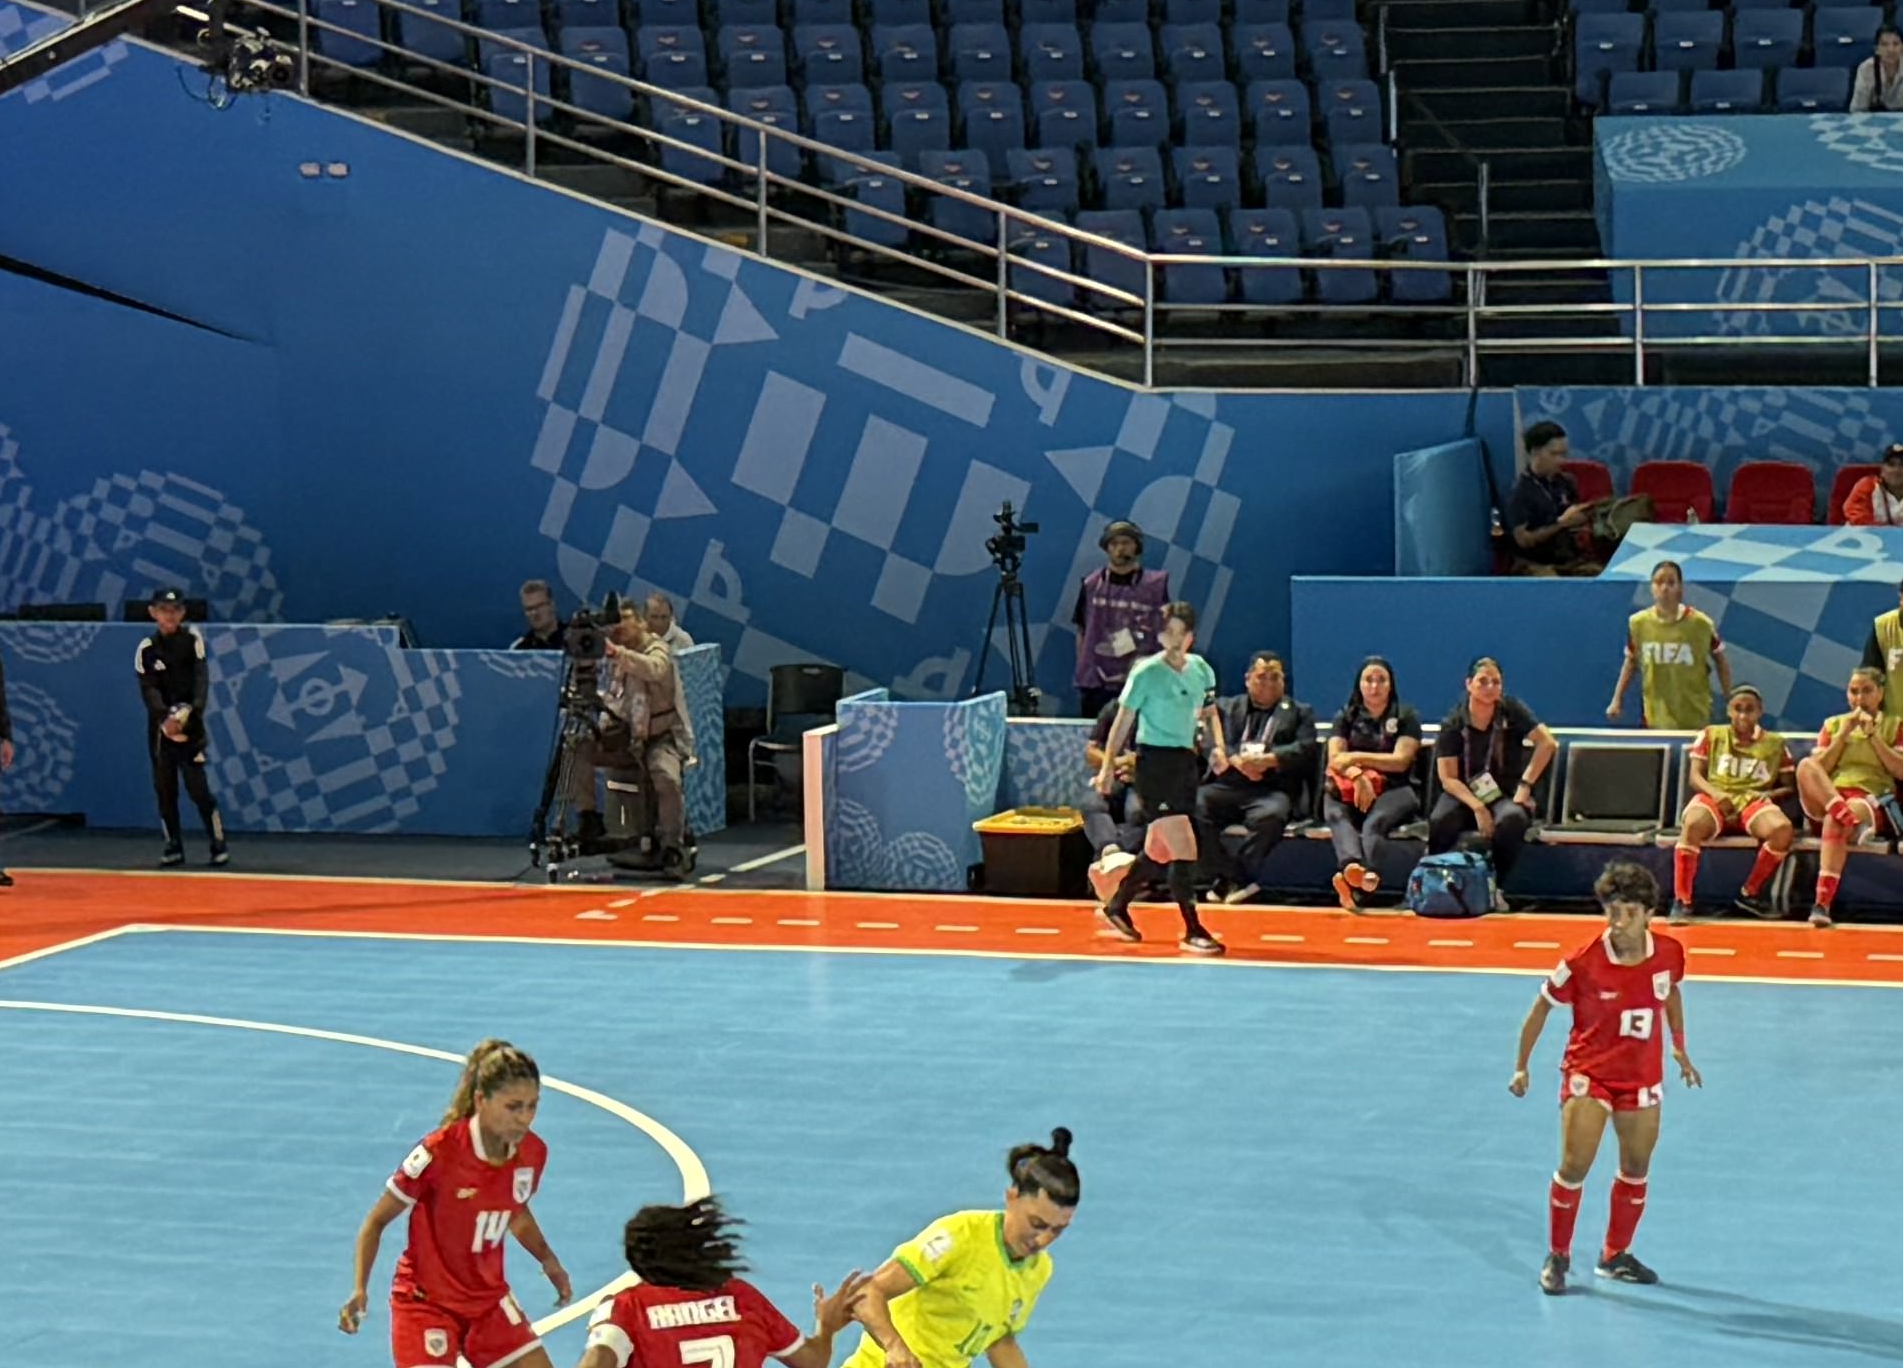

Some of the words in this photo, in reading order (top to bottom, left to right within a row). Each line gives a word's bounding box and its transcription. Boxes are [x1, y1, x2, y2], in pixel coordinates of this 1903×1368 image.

[1641, 641, 1694, 666] FIFA
[1717, 753, 1770, 782] FIFA
[1619, 1008, 1653, 1040] 13
[471, 1210, 512, 1253] 14
